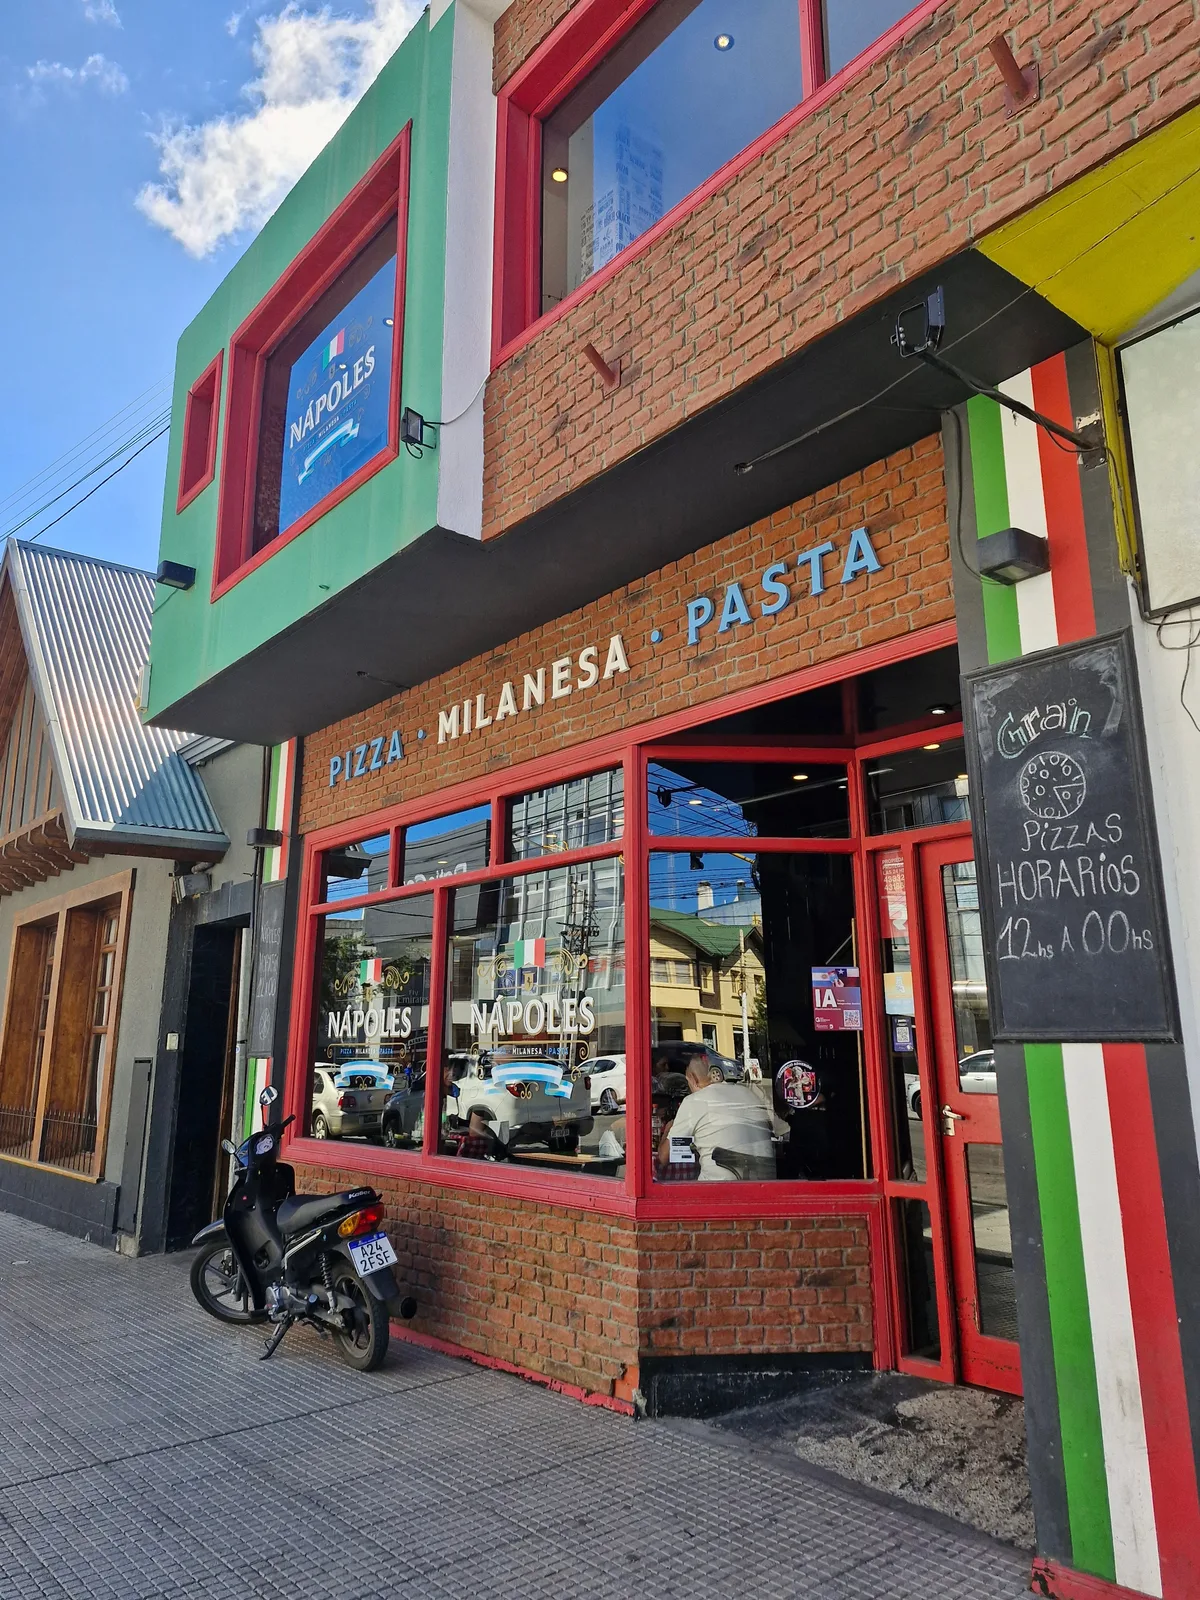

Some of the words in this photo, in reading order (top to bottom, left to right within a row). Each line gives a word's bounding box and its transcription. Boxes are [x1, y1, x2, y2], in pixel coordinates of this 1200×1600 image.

[289, 345, 375, 449] NÁPOLES
[319, 415, 339, 438] MILANESA
[329, 729, 404, 788] PIZZA
[437, 634, 631, 744] MILANESA
[686, 526, 883, 645] PASTA
[996, 697, 1093, 760] Grain
[1021, 813, 1123, 852] PiZZAS
[1062, 926, 1075, 953] A
[814, 988, 838, 1008] IA
[328, 1005, 412, 1039] NÁPOLES
[470, 994, 596, 1036] NÁPOLES
[512, 1047, 542, 1055] MILANESA
[548, 1047, 569, 1055] PASTA
[360, 1241, 383, 1258] A24
[360, 1250, 390, 1273] 2FSF
